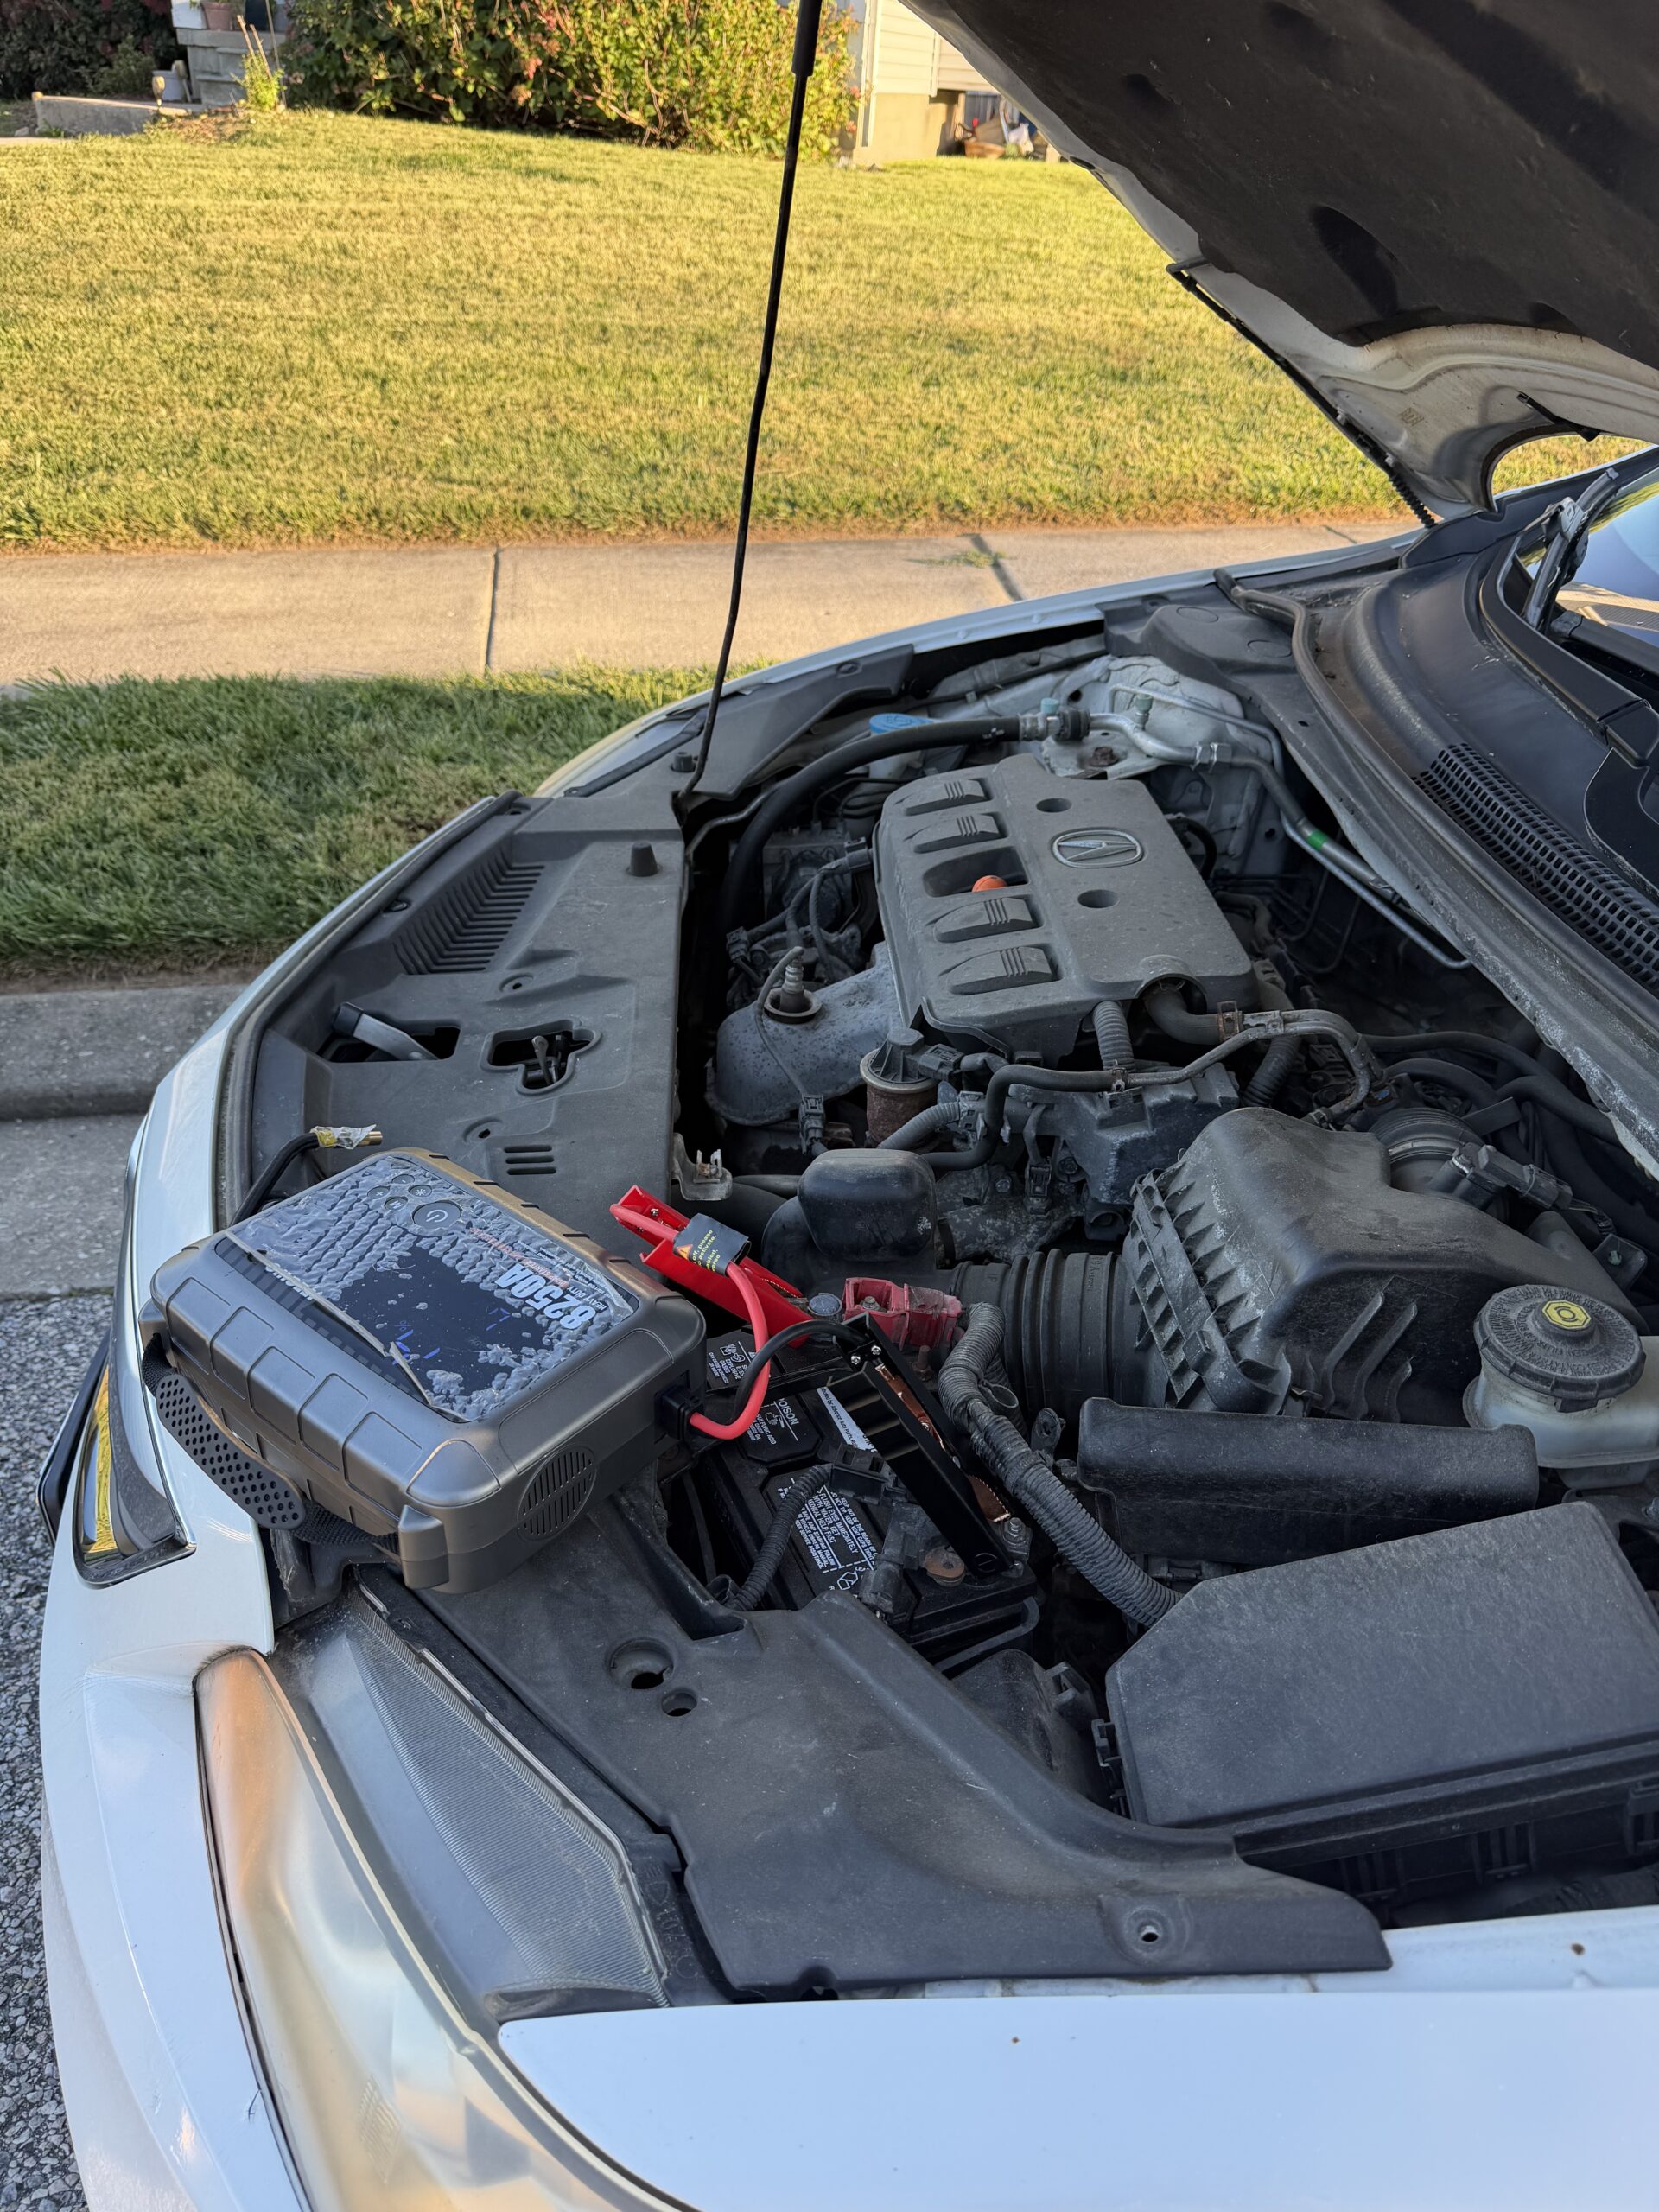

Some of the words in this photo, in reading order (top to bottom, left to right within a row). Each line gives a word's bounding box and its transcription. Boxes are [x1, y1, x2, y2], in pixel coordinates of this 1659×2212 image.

[690, 1249, 699, 1260] off,
[696, 1229, 713, 1249] please
[697, 1236, 716, 1260] activate.
[705, 1249, 718, 1268] abled,
[493, 1260, 597, 1330] 8250A
[566, 1285, 586, 1298] DUTY
[583, 1294, 607, 1311] HEAVY
[719, 1360, 730, 1373] GASES
[725, 1358, 741, 1379] EXPLOSIVE
[777, 1397, 798, 1425] OISON
[830, 1405, 842, 1420] Advance
[756, 1414, 771, 1433] SULFURIC
[766, 1434, 776, 1445] ACID
[812, 1494, 823, 1508] WITH
[830, 1526, 840, 1536] GET
[818, 1492, 832, 1509] FLUSH
[828, 1509, 839, 1522] EYES
[835, 1522, 858, 1554] IMMEDIATELY
[840, 1497, 849, 1508] KEEP
[847, 1508, 855, 1516] OUT
[861, 1532, 872, 1546] REACH
[799, 1529, 811, 1545] SERVICE
[817, 1517, 829, 1531] HELP
[824, 1530, 836, 1543] FAST
[844, 1515, 854, 1525] KEEP
[850, 1525, 860, 1535] VENT
[856, 1536, 867, 1547] CAPS
[863, 1548, 874, 1560] TIGHT
[823, 1549, 836, 1565] FOLLOW
